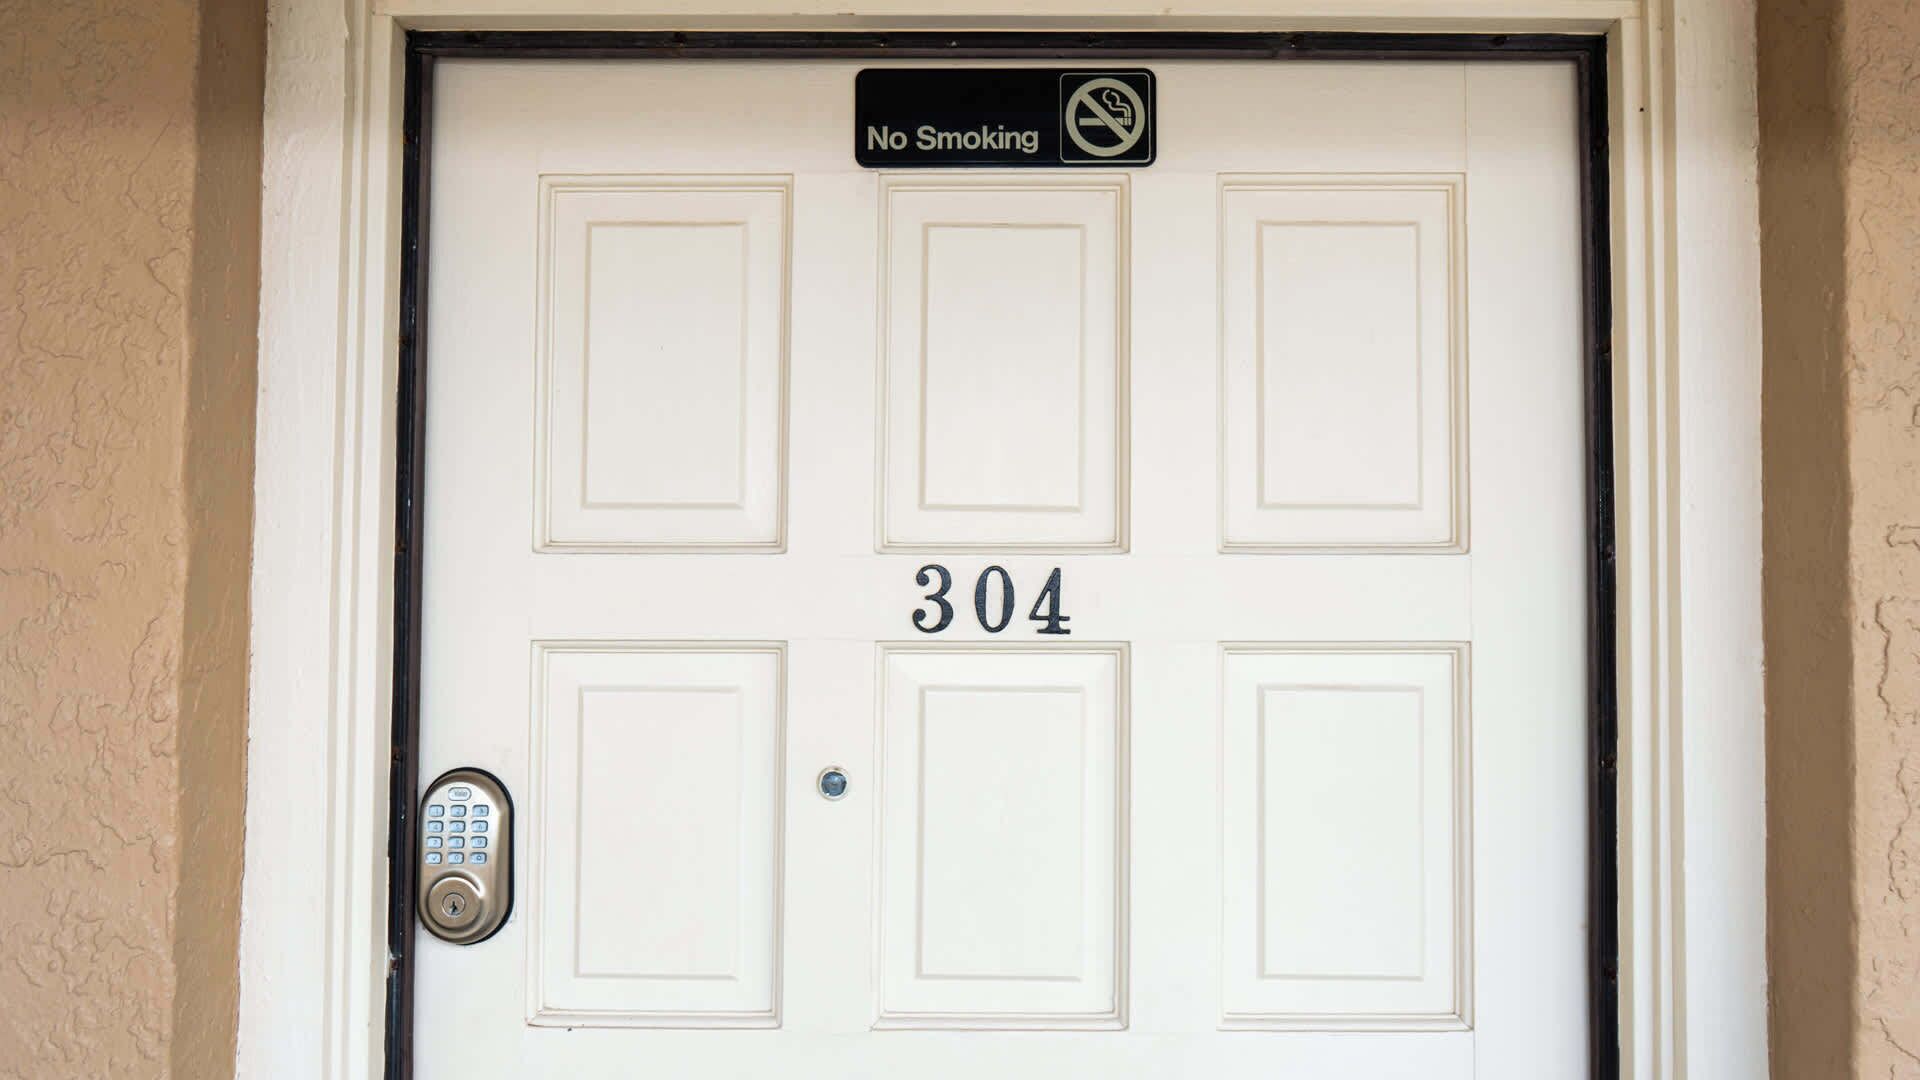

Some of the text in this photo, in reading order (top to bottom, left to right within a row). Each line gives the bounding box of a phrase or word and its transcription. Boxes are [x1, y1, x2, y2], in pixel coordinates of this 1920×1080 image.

[867, 125, 1039, 153] No Smoking
[911, 563, 1072, 635] 304
